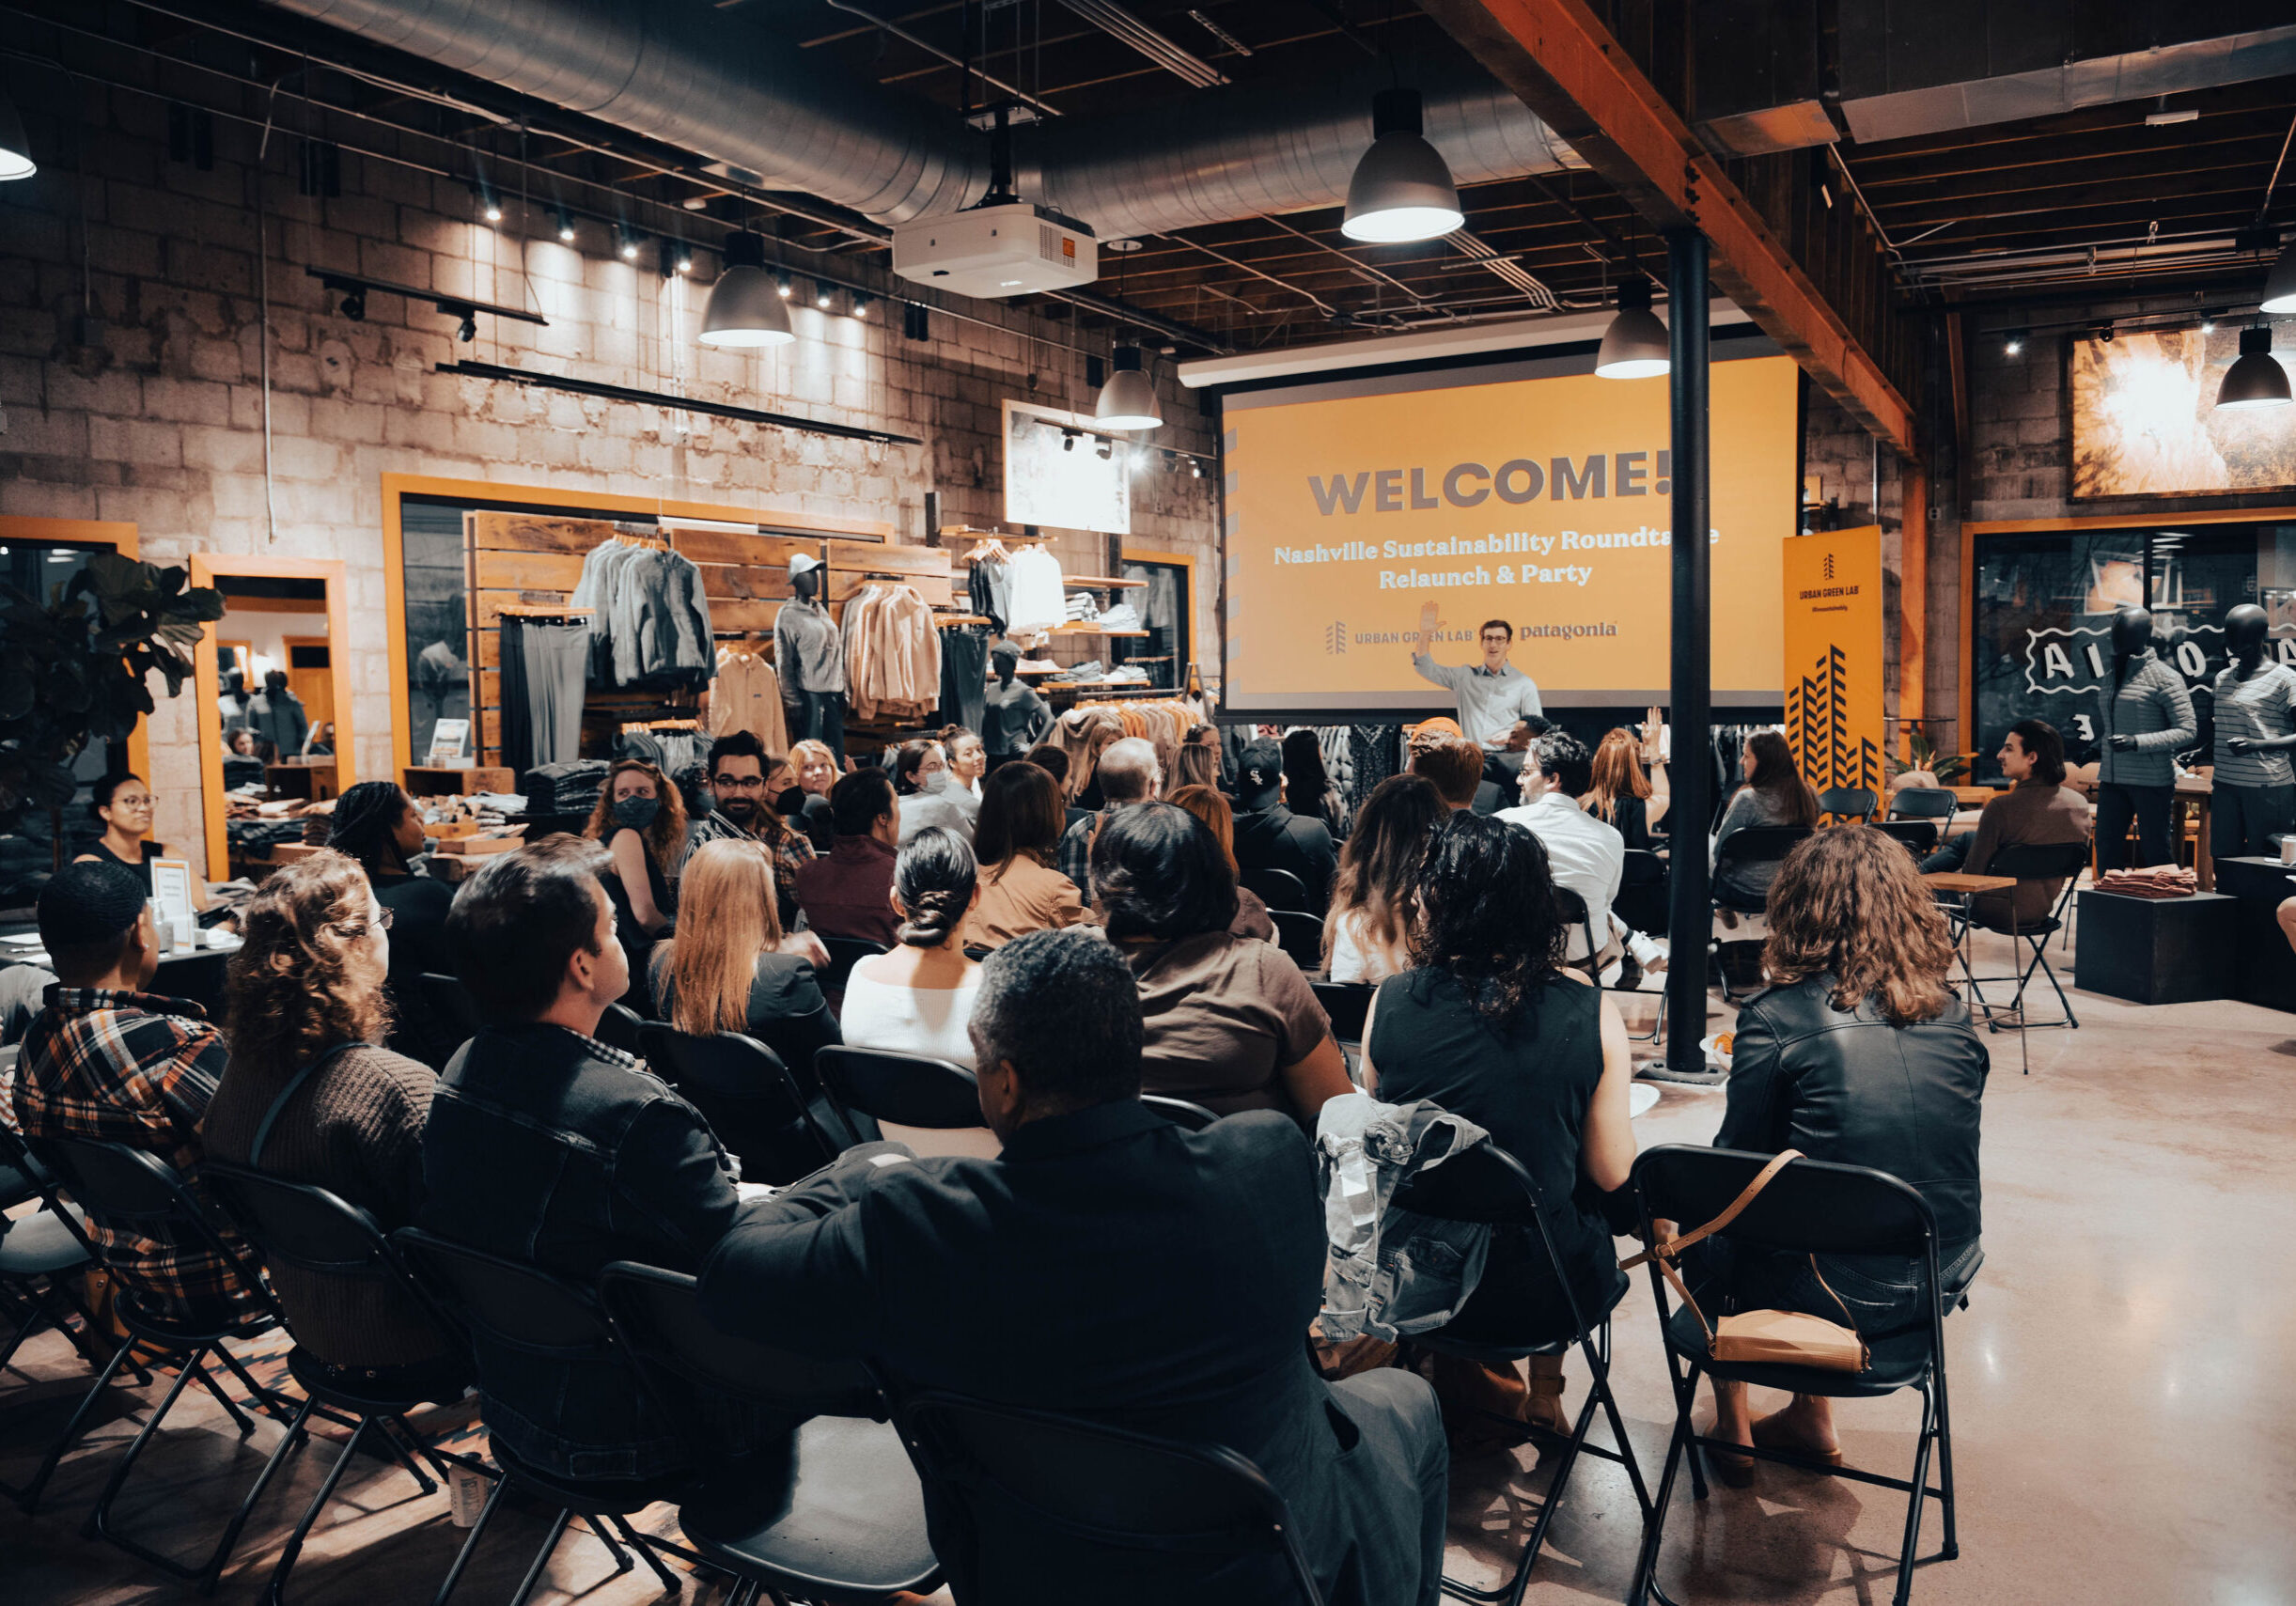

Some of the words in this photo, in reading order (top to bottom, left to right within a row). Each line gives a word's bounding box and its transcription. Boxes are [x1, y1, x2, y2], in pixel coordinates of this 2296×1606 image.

[1307, 449, 1670, 516] WELCOME!
[1273, 541, 1379, 564] Nashville
[1382, 532, 1555, 558] Sustainability
[1560, 525, 1720, 550] Roundtae
[1379, 566, 1491, 589] Relaunch
[1496, 565, 1516, 584] &
[1521, 564, 1593, 586] Party
[1799, 589, 1821, 600] URBAN
[1822, 587, 1844, 598] GREEN
[1845, 585, 1859, 596] LAB
[1355, 632, 1399, 644] URBAN
[1402, 631, 1445, 643] GREN
[1448, 631, 1473, 642] LAB
[1520, 621, 1617, 641] patagonia
